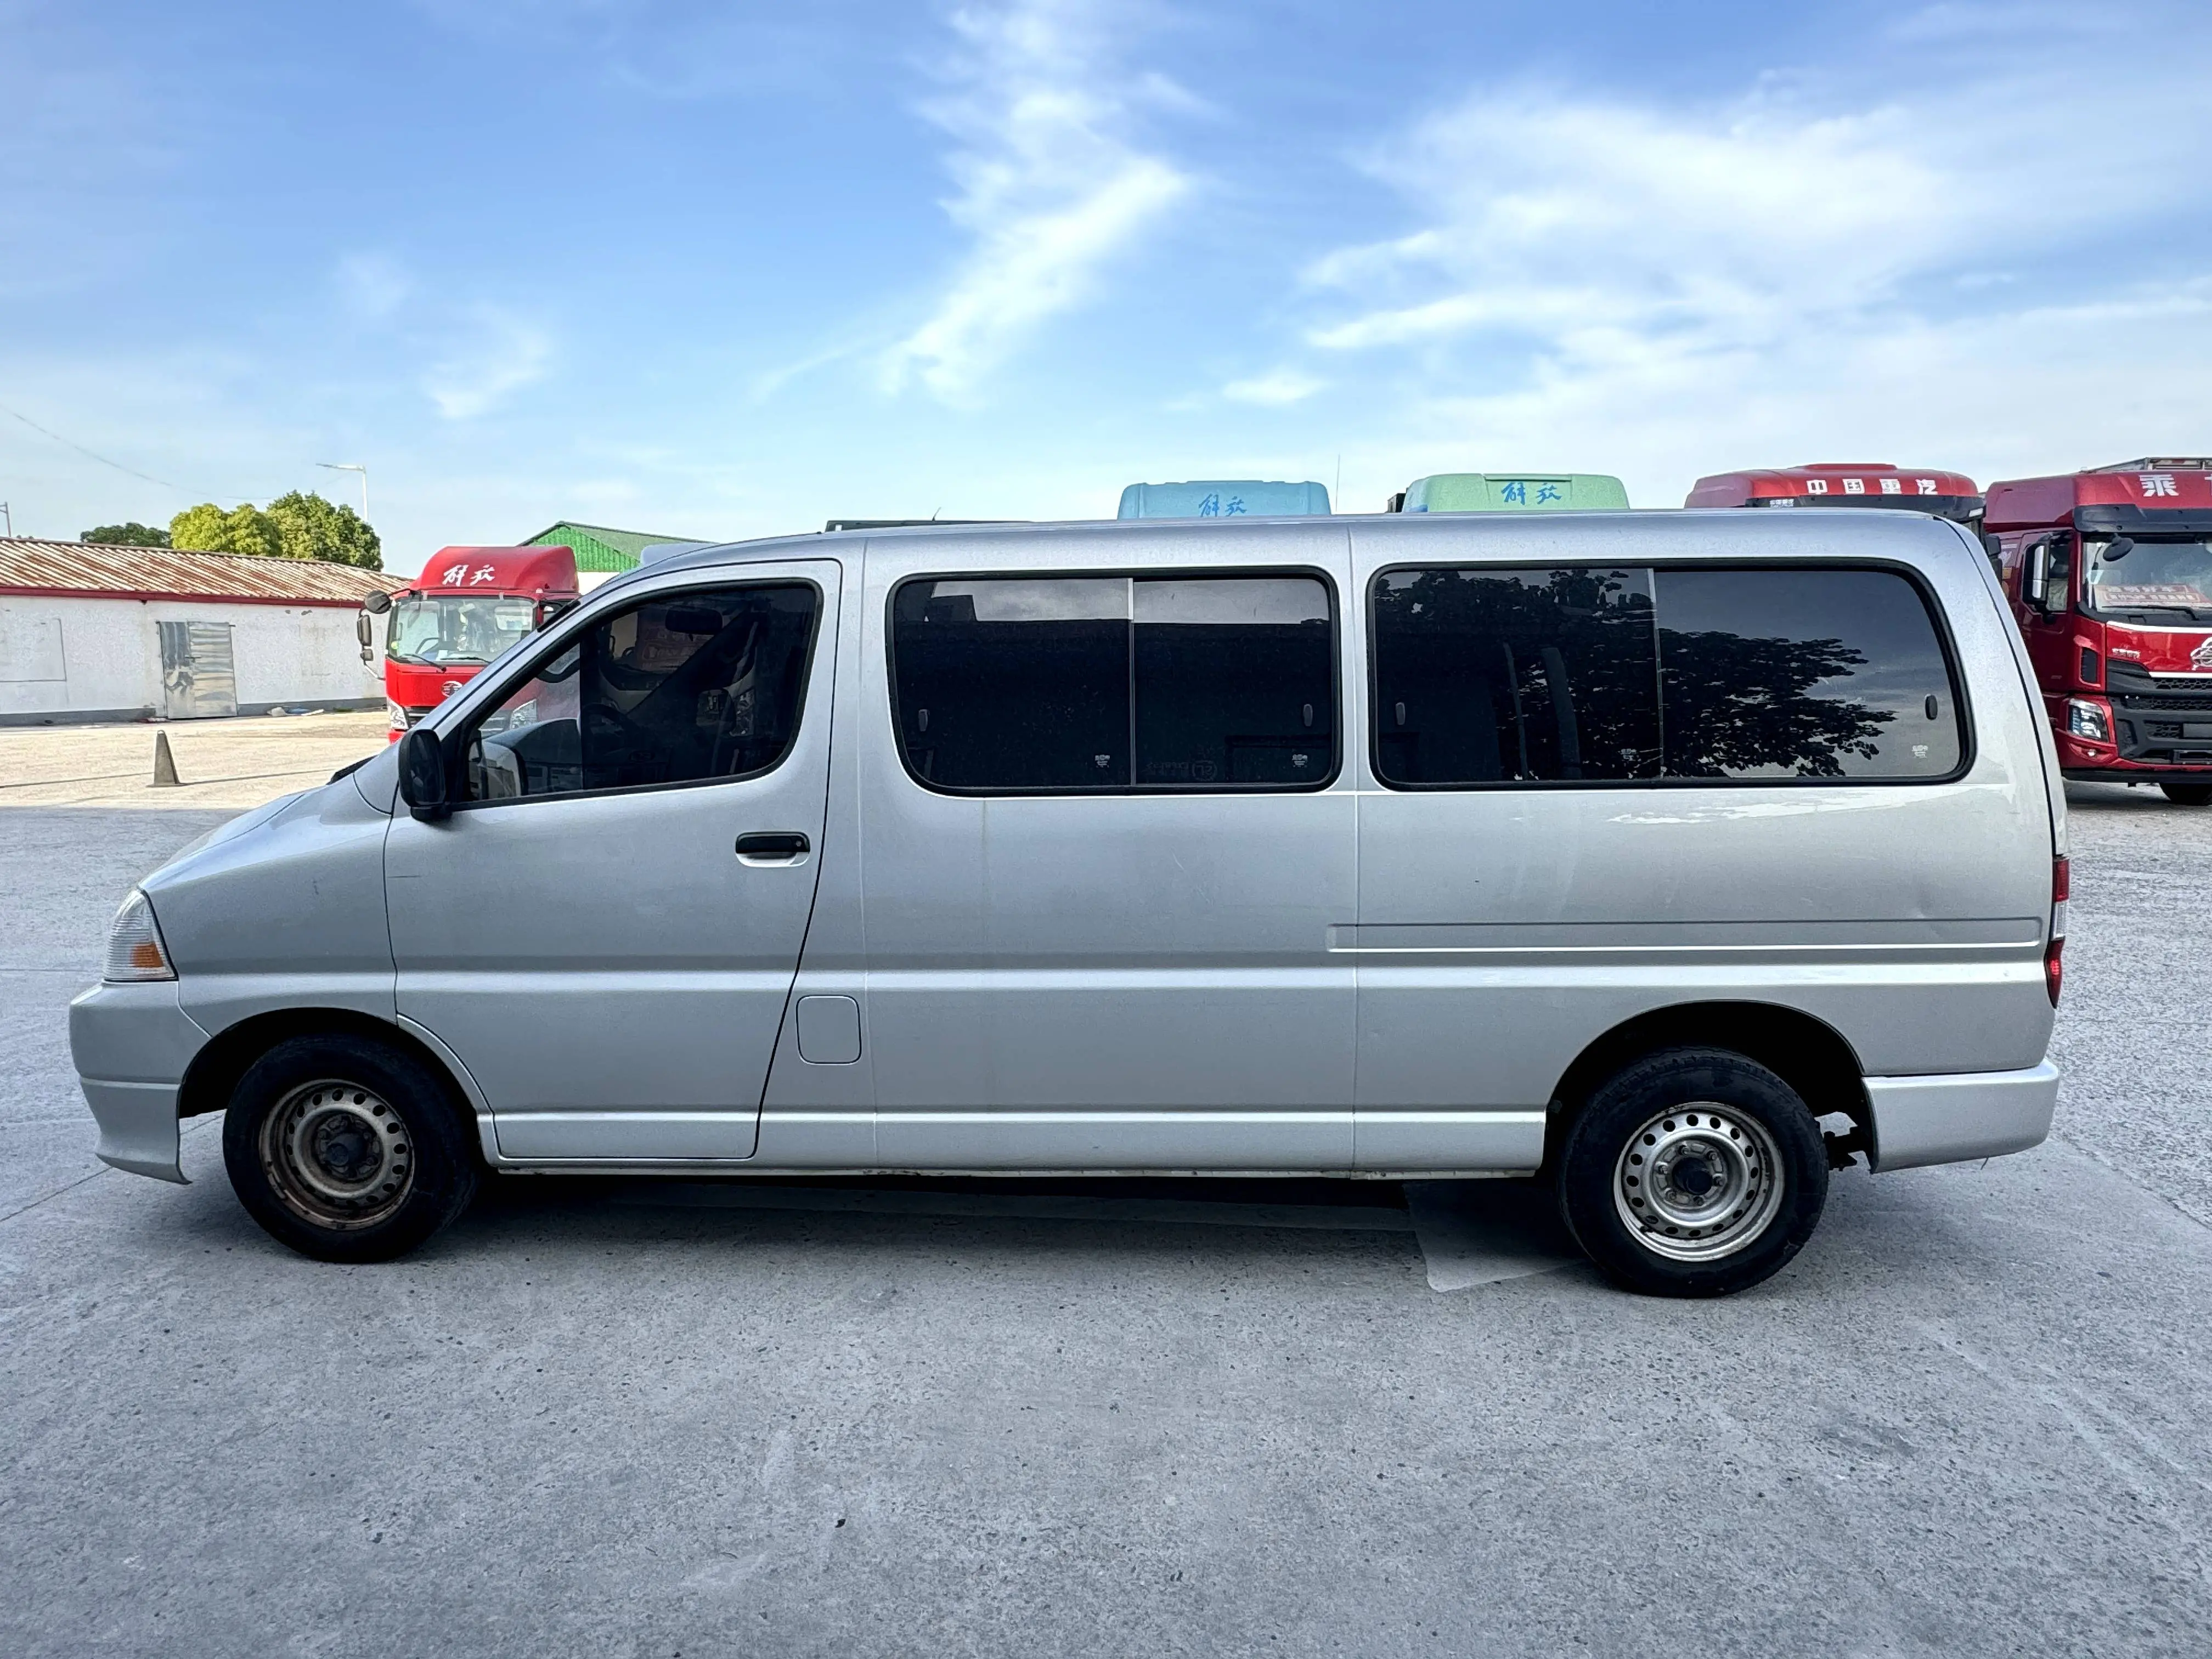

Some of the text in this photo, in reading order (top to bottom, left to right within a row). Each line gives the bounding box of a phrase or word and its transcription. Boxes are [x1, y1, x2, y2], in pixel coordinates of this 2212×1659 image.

[1501, 482, 1562, 505] 解放
[1807, 478, 1938, 495] 中国重汽
[2139, 474, 2212, 497] 乘
[1198, 493, 1248, 517] 解放
[442, 564, 496, 586] 解放
